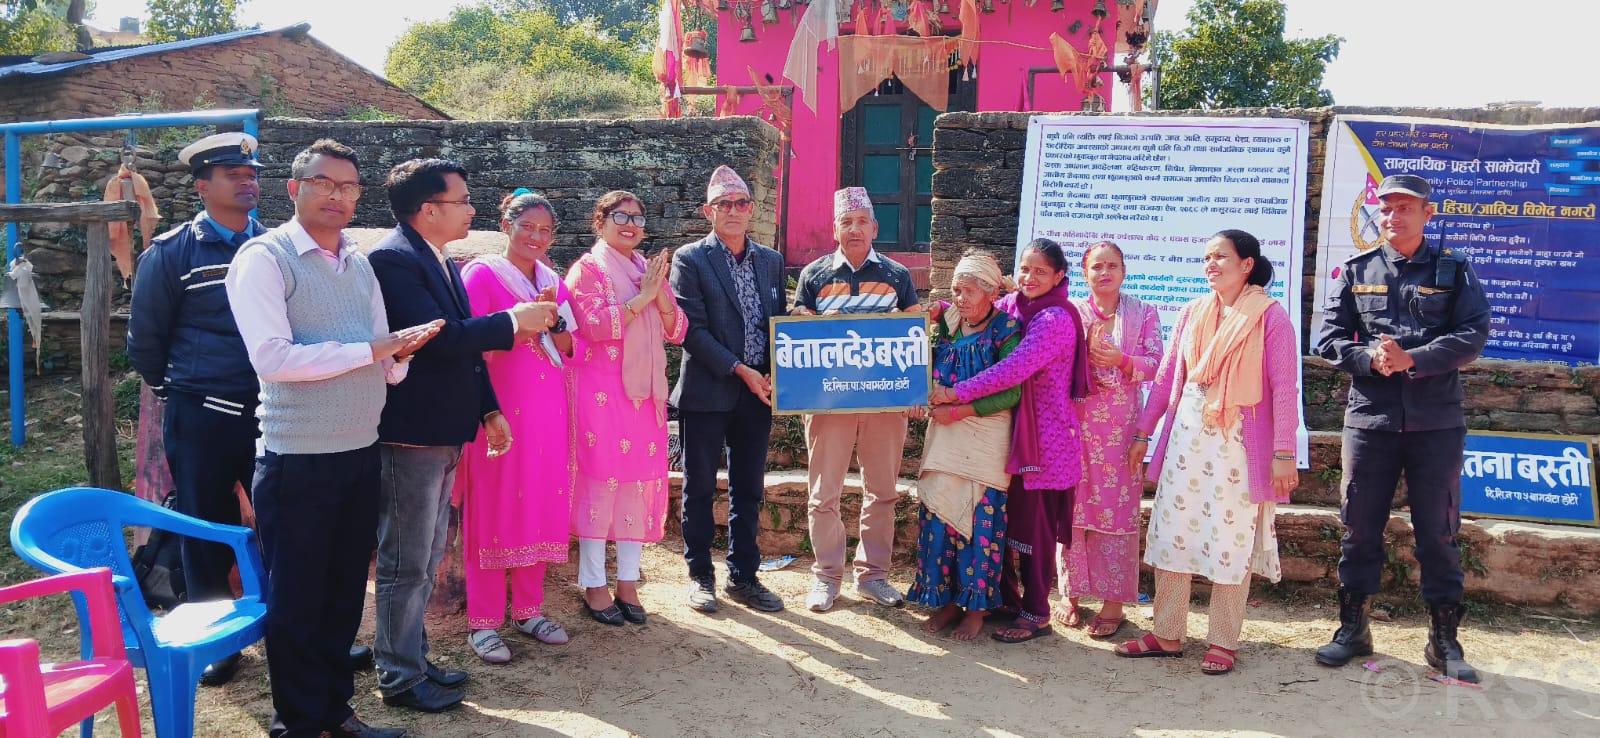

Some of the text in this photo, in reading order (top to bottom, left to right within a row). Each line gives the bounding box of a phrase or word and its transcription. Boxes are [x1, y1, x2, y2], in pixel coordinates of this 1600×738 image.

[1062, 132, 1075, 141] पनि
[1484, 158, 1542, 174] साझेदारी
[1427, 177, 1528, 189] nity-Police Partnership
[1523, 201, 1557, 217] विभेद
[1461, 446, 1592, 488] तना बस्ती
